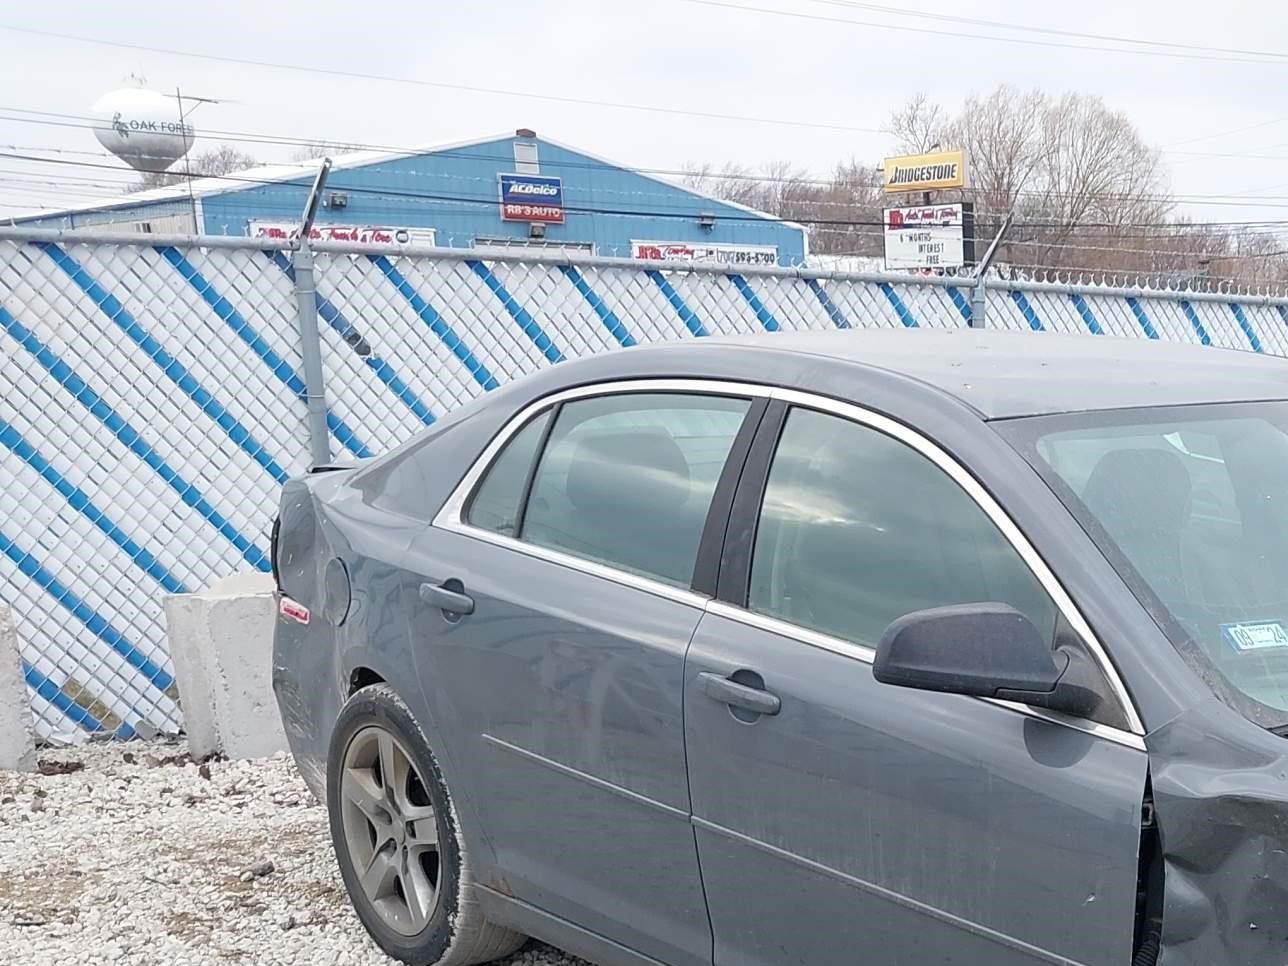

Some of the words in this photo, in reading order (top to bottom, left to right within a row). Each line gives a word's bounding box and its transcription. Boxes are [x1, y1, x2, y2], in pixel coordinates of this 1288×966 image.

[129, 120, 157, 131] OAK
[889, 164, 957, 184] BRIDGESTONE
[532, 206, 560, 217] AUTO
[918, 243, 944, 254] INTEREST
[926, 255, 940, 265] FREE
